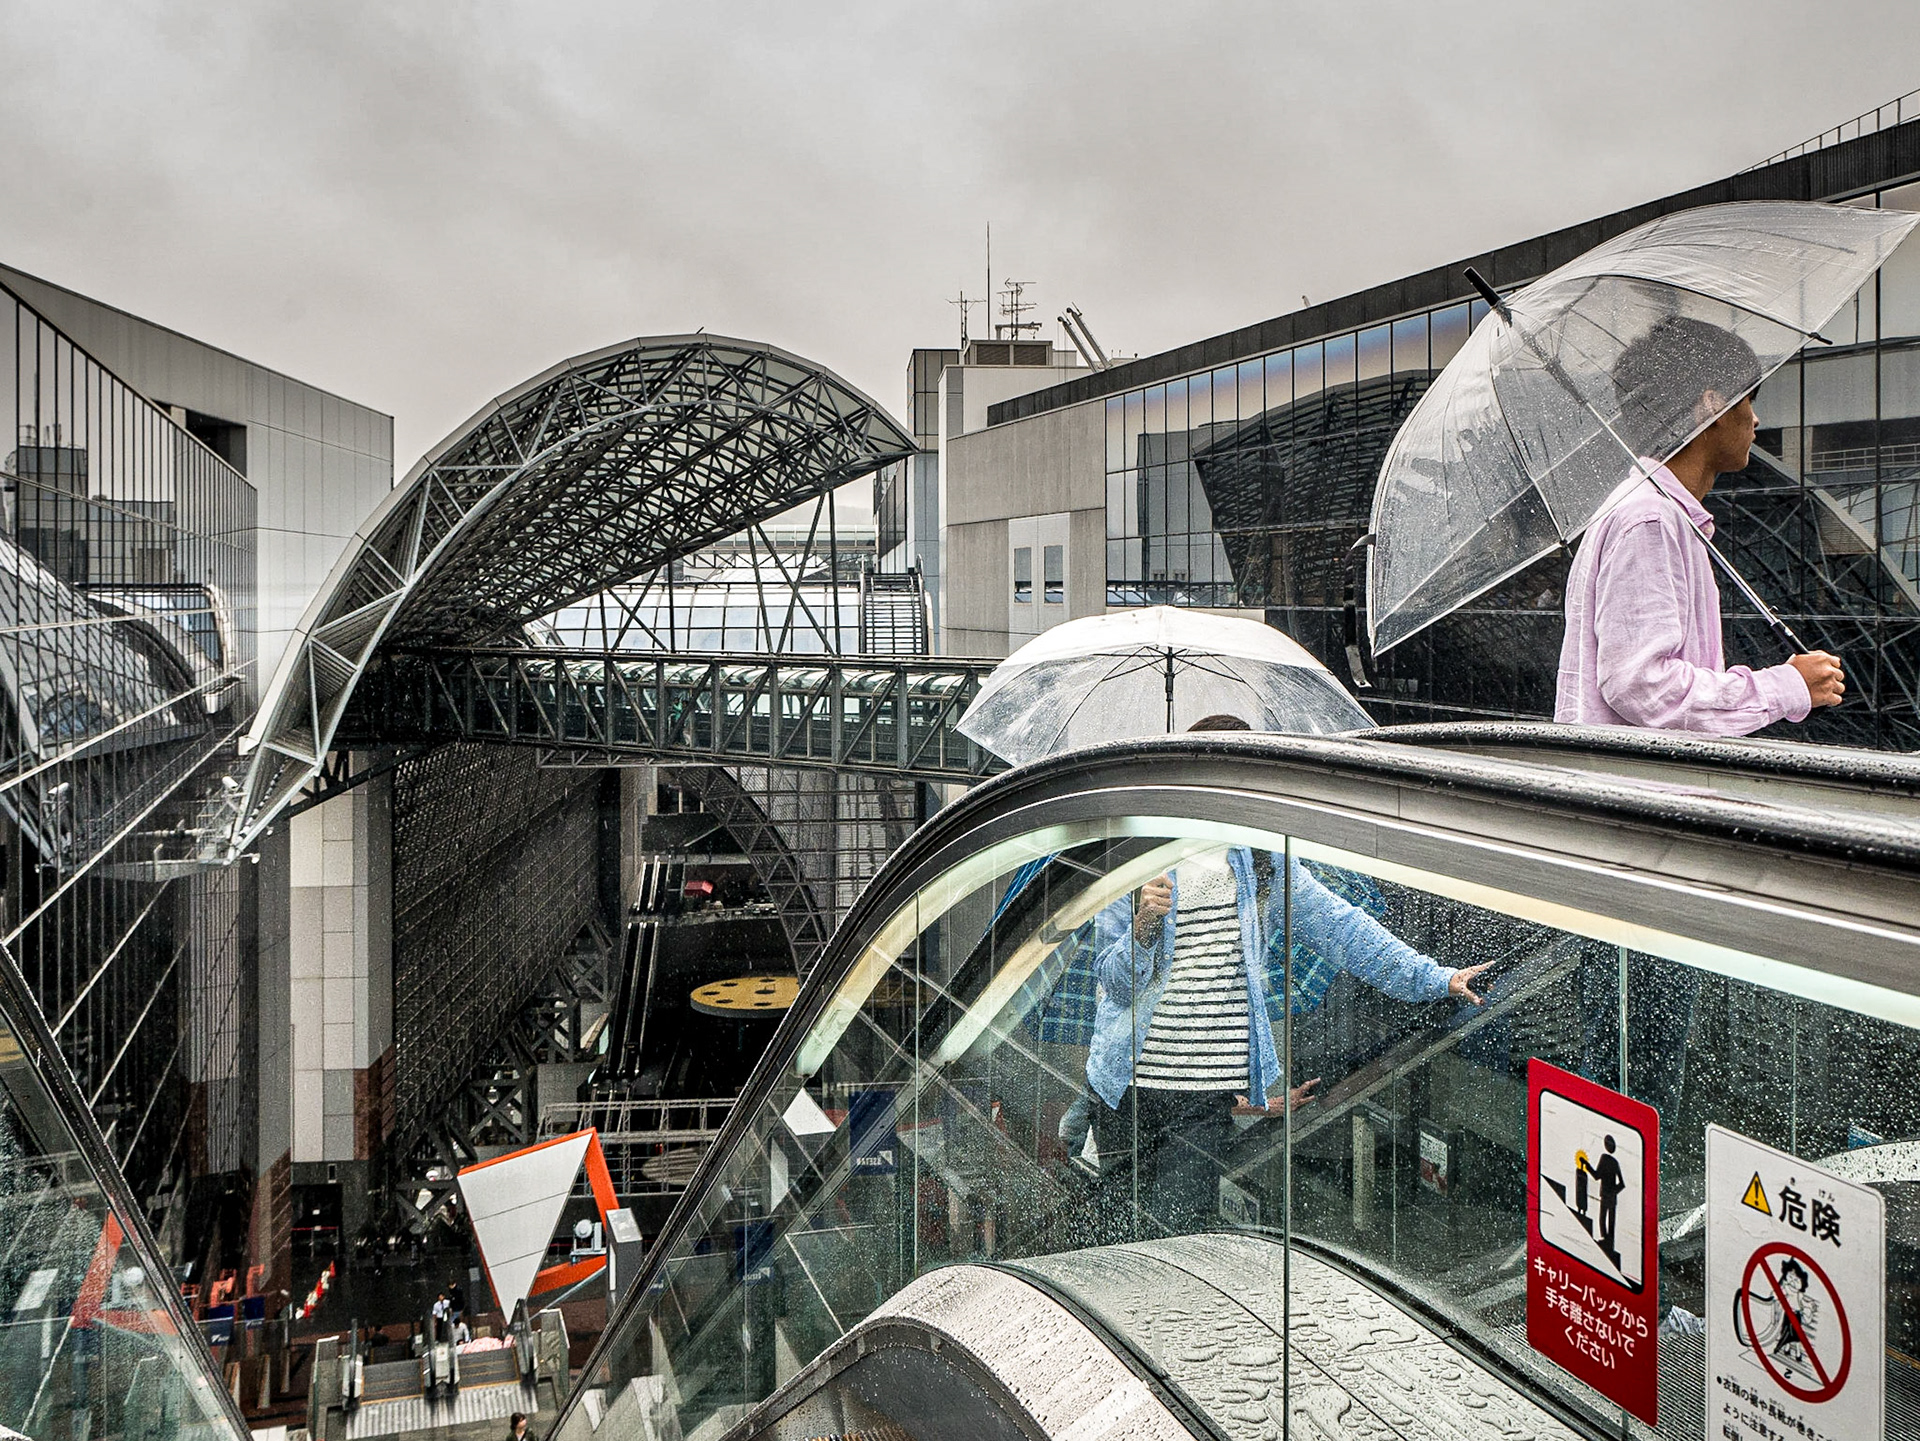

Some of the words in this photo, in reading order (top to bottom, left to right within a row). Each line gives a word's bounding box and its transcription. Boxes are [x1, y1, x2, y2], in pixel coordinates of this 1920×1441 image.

[1778, 1185, 1842, 1248] 危険
[1533, 1256, 1648, 1338] キャリーバッグから
[1545, 1286, 1635, 1358] 手を離さないで
[1564, 1325, 1616, 1370] ください
